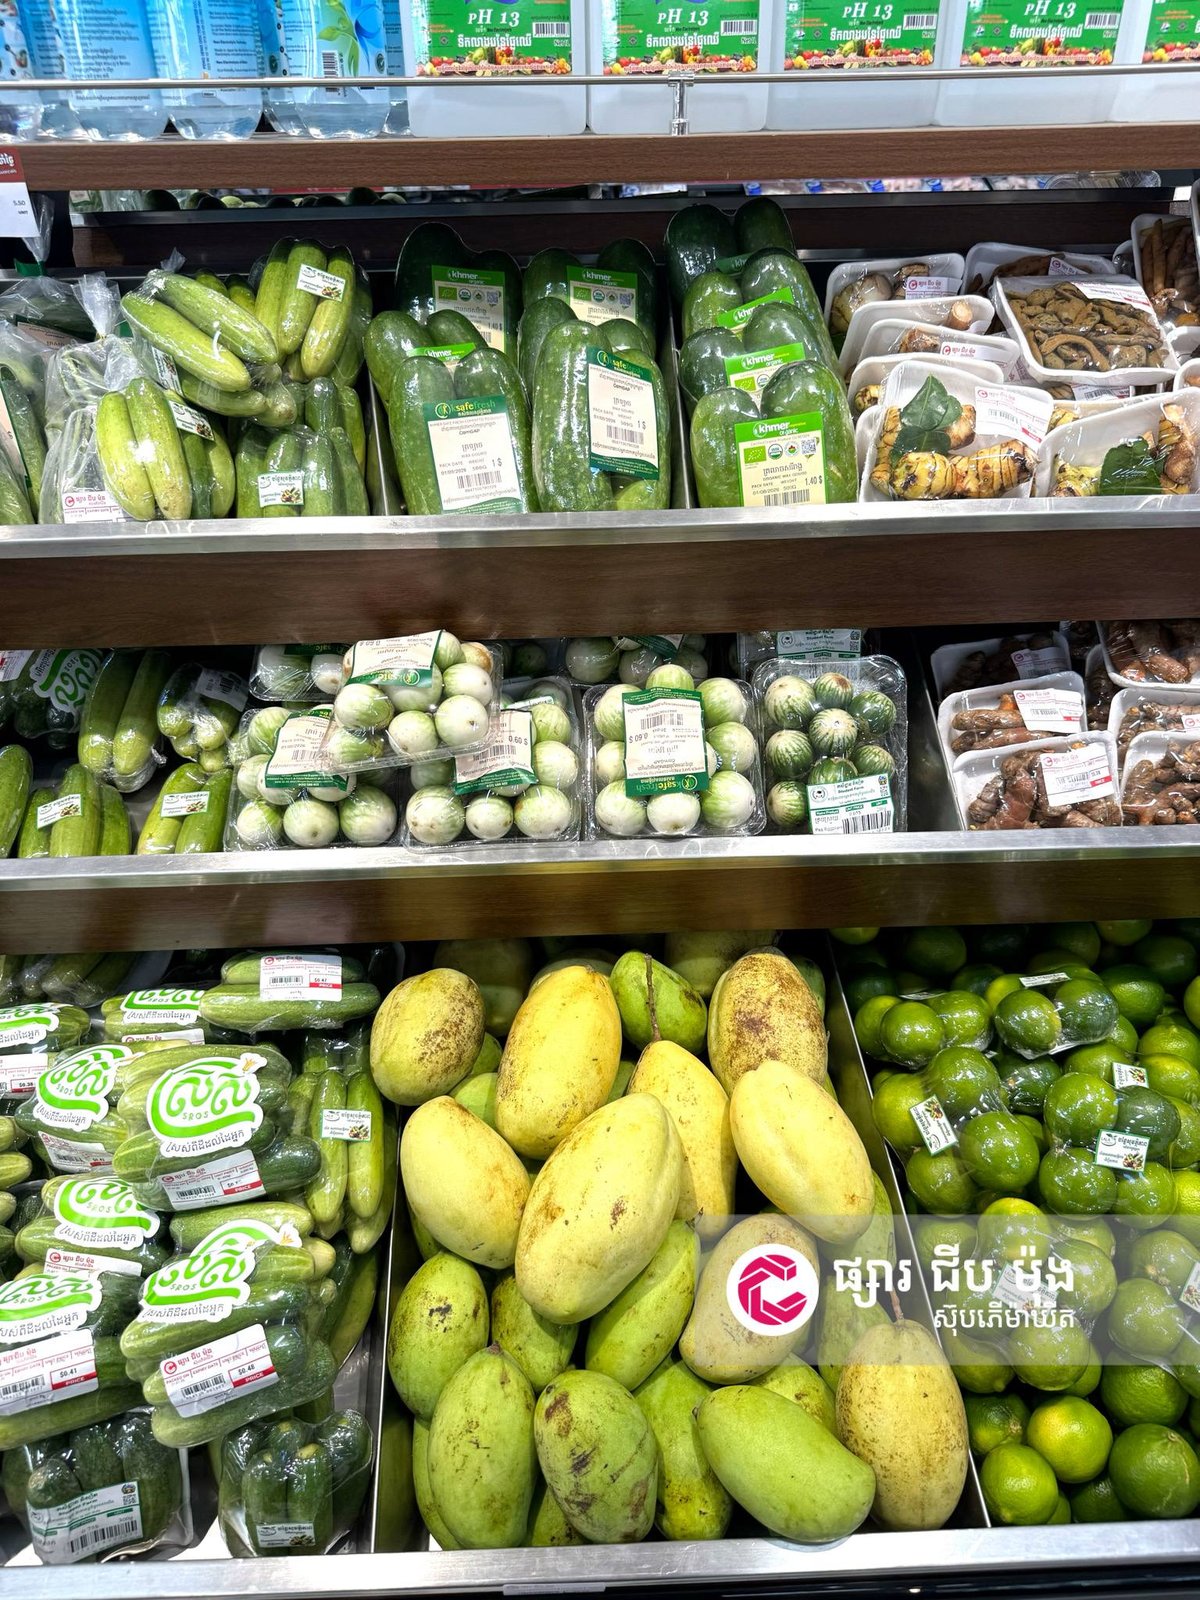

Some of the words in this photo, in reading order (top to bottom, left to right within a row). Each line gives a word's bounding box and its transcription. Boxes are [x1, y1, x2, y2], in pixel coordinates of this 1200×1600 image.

[873, 5, 894, 20] 13
[1055, 2, 1077, 19] 13
[500, 11, 520, 27] 13
[688, 11, 710, 27] 13
[450, 270, 479, 281] khmer
[585, 271, 613, 282] khmer
[745, 353, 776, 366] khmer
[758, 421, 791, 433] khmer
[804, 476, 818, 486] 1.40
[818, 475, 823, 485] $
[628, 735, 634, 744] $
[634, 732, 649, 743] 0.60
[181, 1110, 210, 1121] SROS
[165, 1129, 245, 1153] ស្រស់ពីដីដល់ដៃអ្នក
[234, 1185, 252, 1193] PRICE
[86, 1202, 112, 1214] SROS
[59, 1225, 137, 1245] ស្រស់ពីដីដល់ដៃអ្នក
[170, 1283, 197, 1292] SROS
[14, 1295, 43, 1305] SROS
[177, 1357, 190, 1367] ផ្សារ
[190, 1352, 202, 1362] ជីប
[202, 1348, 213, 1358] ម៉ុង
[59, 1367, 78, 1379] $0.41
[244, 1372, 265, 1383] PRICE
[64, 1377, 86, 1387] PRICE
